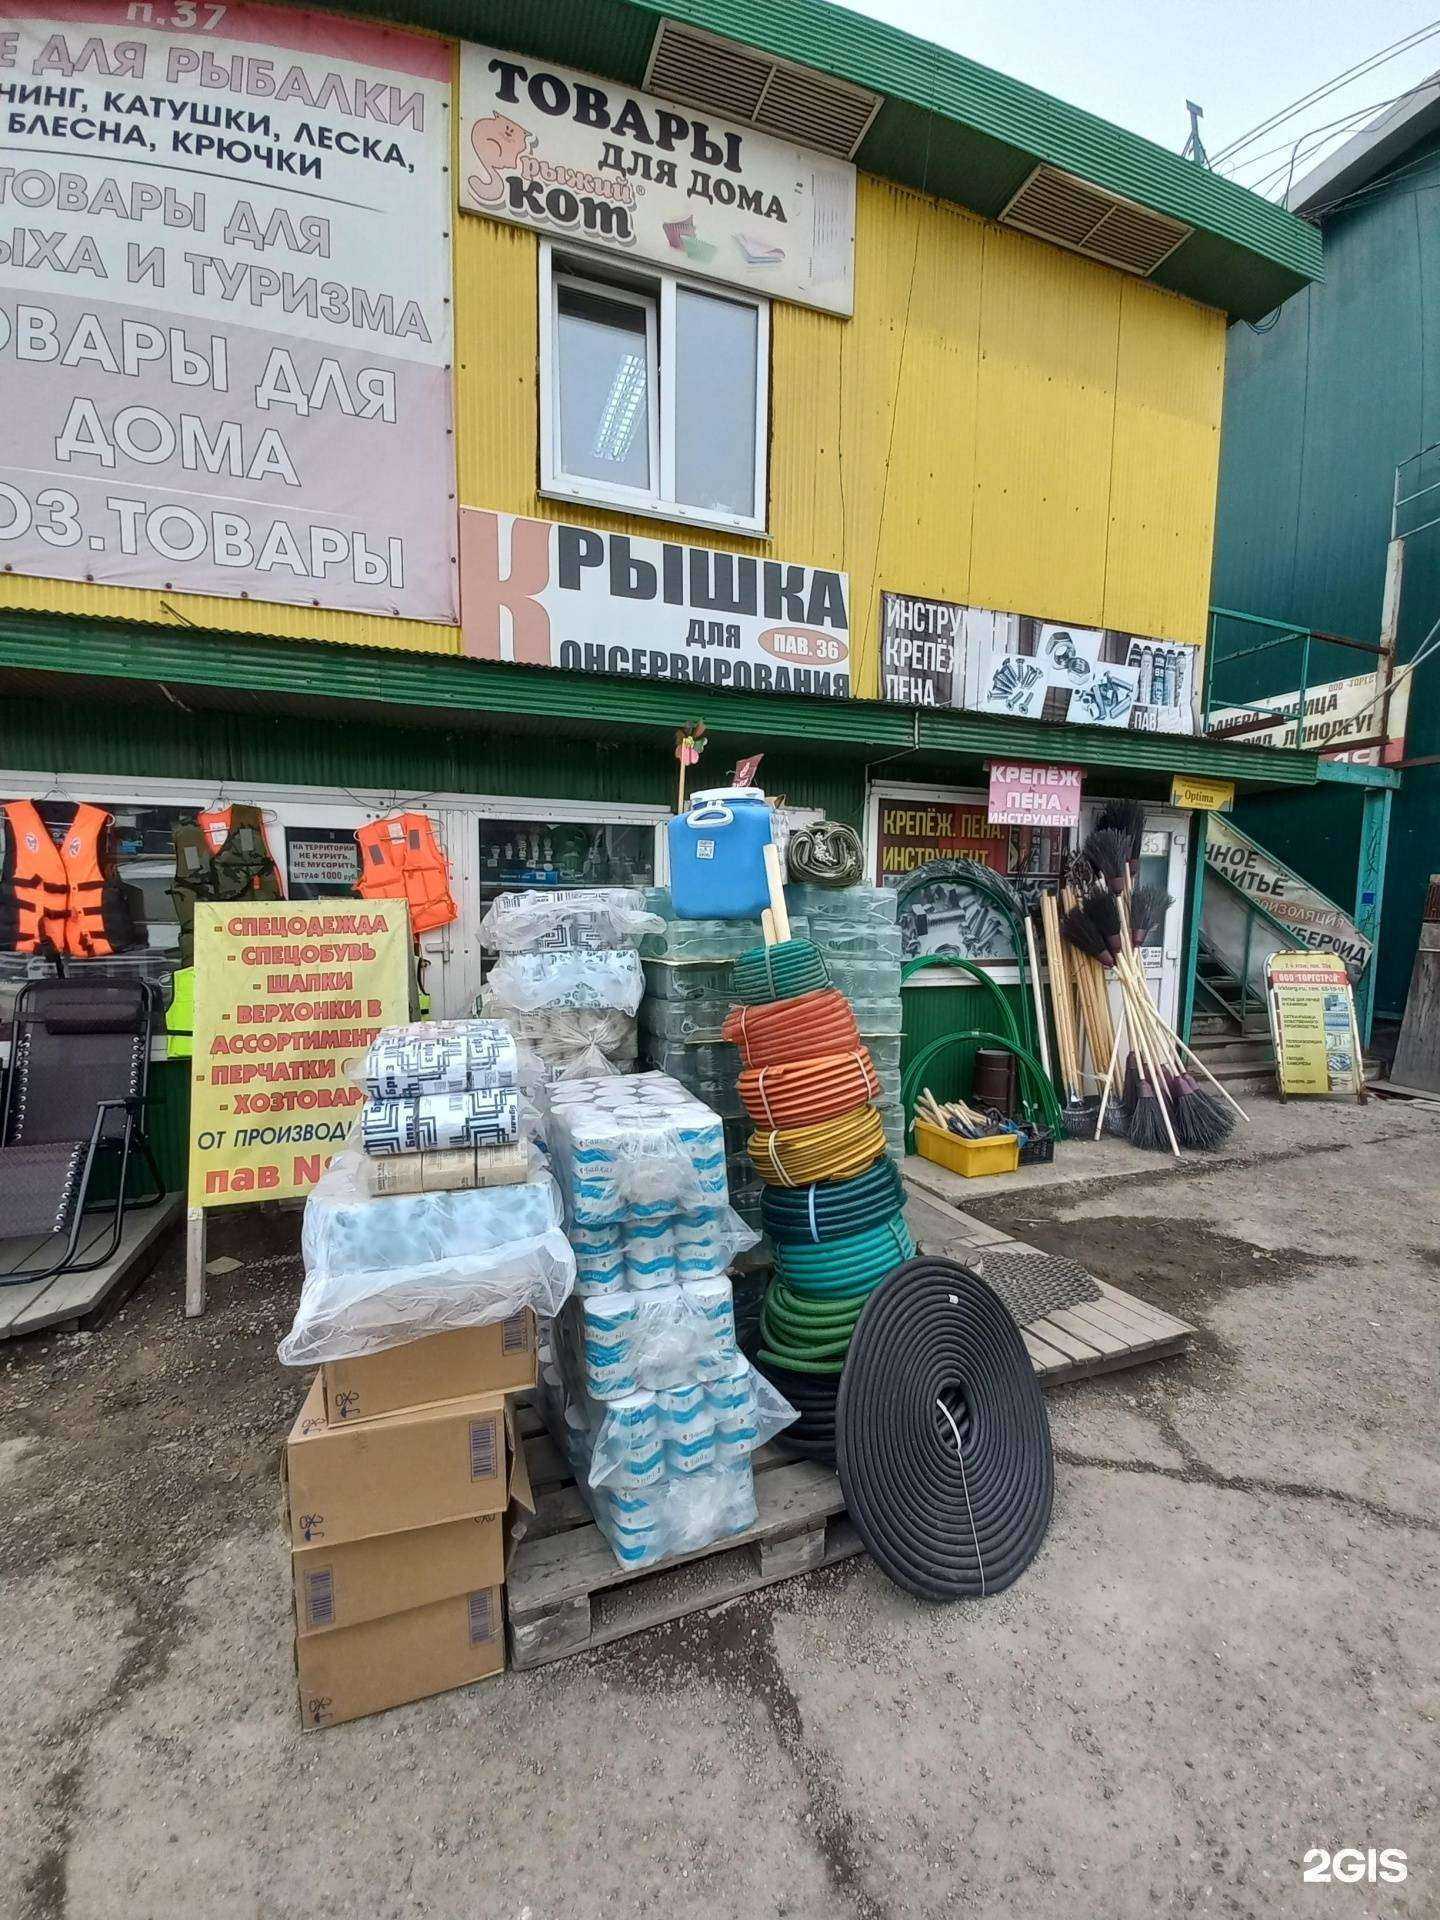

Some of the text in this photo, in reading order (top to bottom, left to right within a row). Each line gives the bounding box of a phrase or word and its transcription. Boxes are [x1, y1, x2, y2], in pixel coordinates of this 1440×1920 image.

[32, 34, 147, 79] ДЛЯ
[166, 47, 425, 132] РЫБАЛКИ
[488, 58, 743, 173] ТОВАРЫ
[8, 112, 323, 180] БЛЕСНА, КРЮЧКИ
[104, 91, 280, 143] КАТУШКИ,
[293, 122, 415, 174] ЛЕСКА,
[597, 141, 788, 224] ДЛЯ ДОМА
[224, 200, 330, 259] ДЛЯ
[127, 242, 166, 288] И
[184, 252, 432, 344] ТУРИЗМА
[0, 304, 397, 424] ВАРЫ ДЛЯ
[55, 396, 302, 488] ДОМА
[686, 619, 741, 650] ДЛЯ
[774, 632, 839, 659] ПАВ. 36
[990, 766, 1080, 787] КРЕПЁЖ
[1006, 792, 1061, 811] ПЕНА
[1185, 790, 1213, 803] Optima
[989, 812, 1077, 827] ИНСТРУМЕНТ
[321, 871, 342, 880] 1000
[227, 914, 389, 938] СПЕЦОДЕЖДА
[241, 943, 376, 966] СПЕЦОБУВЬ
[267, 972, 353, 993] ШАПКИ
[237, 999, 382, 1024] ВЕРХОНКИ В
[211, 1059, 336, 1085] ПЕРЧАТКИ
[233, 1086, 368, 1114] ХОЗТОВАР
[197, 1131, 226, 1150] ОТ
